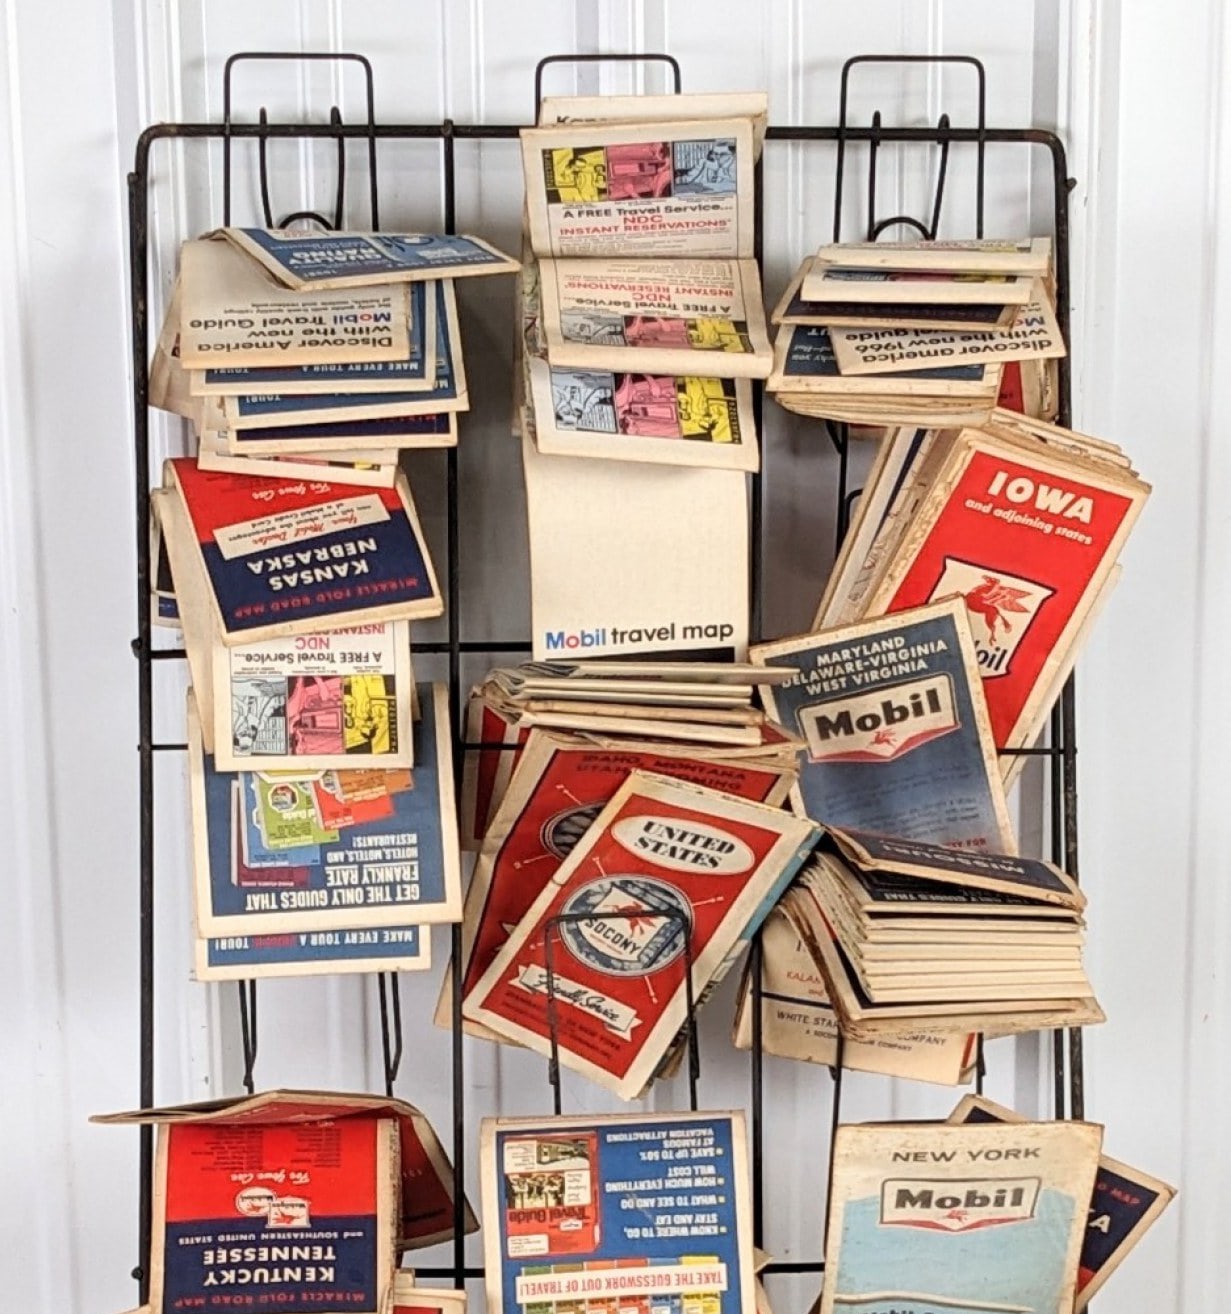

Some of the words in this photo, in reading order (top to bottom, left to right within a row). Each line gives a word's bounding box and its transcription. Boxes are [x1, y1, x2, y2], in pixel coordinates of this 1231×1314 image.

[562, 209, 573, 219] A
[577, 208, 612, 218] FREE
[616, 206, 661, 217] Travel
[623, 215, 663, 225] NDC
[559, 224, 620, 236] INSTANT
[190, 318, 255, 329] Guide
[263, 316, 328, 327] Travel
[333, 312, 391, 322] Mobil
[247, 328, 293, 338] new
[301, 326, 338, 336] the
[343, 325, 391, 335] with
[1006, 327, 1048, 339] with
[298, 336, 392, 347] Discover
[911, 336, 956, 347] new
[960, 332, 1000, 343] the
[198, 338, 291, 351] America
[856, 340, 904, 353] 1966
[963, 339, 1052, 354] discover
[863, 347, 955, 363] america
[987, 470, 1094, 524] IOWA
[965, 498, 993, 513] and
[994, 506, 1053, 533] adjoining
[1056, 525, 1093, 544] states
[246, 537, 377, 573] NEBRASKA
[269, 560, 369, 591] KANSAS
[545, 629, 606, 650] Mobil
[611, 624, 675, 645] travel
[682, 622, 734, 643] map
[295, 637, 330, 649] NDC
[298, 652, 336, 663] Travel
[341, 652, 369, 662] FREE
[374, 652, 382, 661] A
[816, 636, 905, 667] MARYLAND
[782, 639, 947, 688] DELAWARE-VIRGINIA
[806, 675, 848, 695] WEST
[853, 660, 928, 688] VIRGINIA
[815, 688, 941, 742] Mobil
[642, 821, 736, 855] UNITED
[633, 837, 722, 870] STATES
[882, 845, 1024, 874] MISSOURI
[326, 869, 359, 885] RATE
[363, 866, 419, 882] FRANKLY
[332, 889, 363, 905] ONLY
[368, 887, 393, 902] THE
[396, 885, 419, 900] GET
[245, 893, 278, 911] THAT
[282, 890, 327, 909] GUIDES
[214, 936, 248, 949] TOUR!
[300, 935, 307, 945] A
[311, 933, 340, 945] TOUR
[345, 931, 382, 944] EVERY
[383, 930, 413, 942] MAKE
[584, 917, 643, 956] SOCONY
[777, 1010, 809, 1024] WHITE
[892, 1150, 956, 1163] NEW
[967, 1147, 1042, 1163] YORK
[895, 1187, 1024, 1210] Mobil
[509, 1209, 546, 1224] Guide
[549, 1207, 589, 1221] Travel
[218, 1233, 255, 1242] UNITED
[261, 1232, 338, 1242] SOUTHEASTERN
[641, 1227, 654, 1238] TO
[655, 1226, 688, 1237] WHERE
[691, 1226, 718, 1237] KNOW
[179, 1237, 211, 1245] STATES
[203, 1247, 336, 1266] TENNESSEE
[203, 1267, 335, 1287] KENTUCKY
[606, 1274, 671, 1289] GUESSWORK
[675, 1273, 693, 1285] THE
[697, 1271, 722, 1284] TAKE
[519, 1281, 562, 1296] TRAVEL!
[566, 1280, 578, 1292] OF
[581, 1278, 601, 1291] OUT
[174, 1298, 206, 1308] MAP
[211, 1296, 255, 1307] ROAD
[262, 1294, 294, 1305] FOLD
[302, 1292, 365, 1301] MIRACLE
